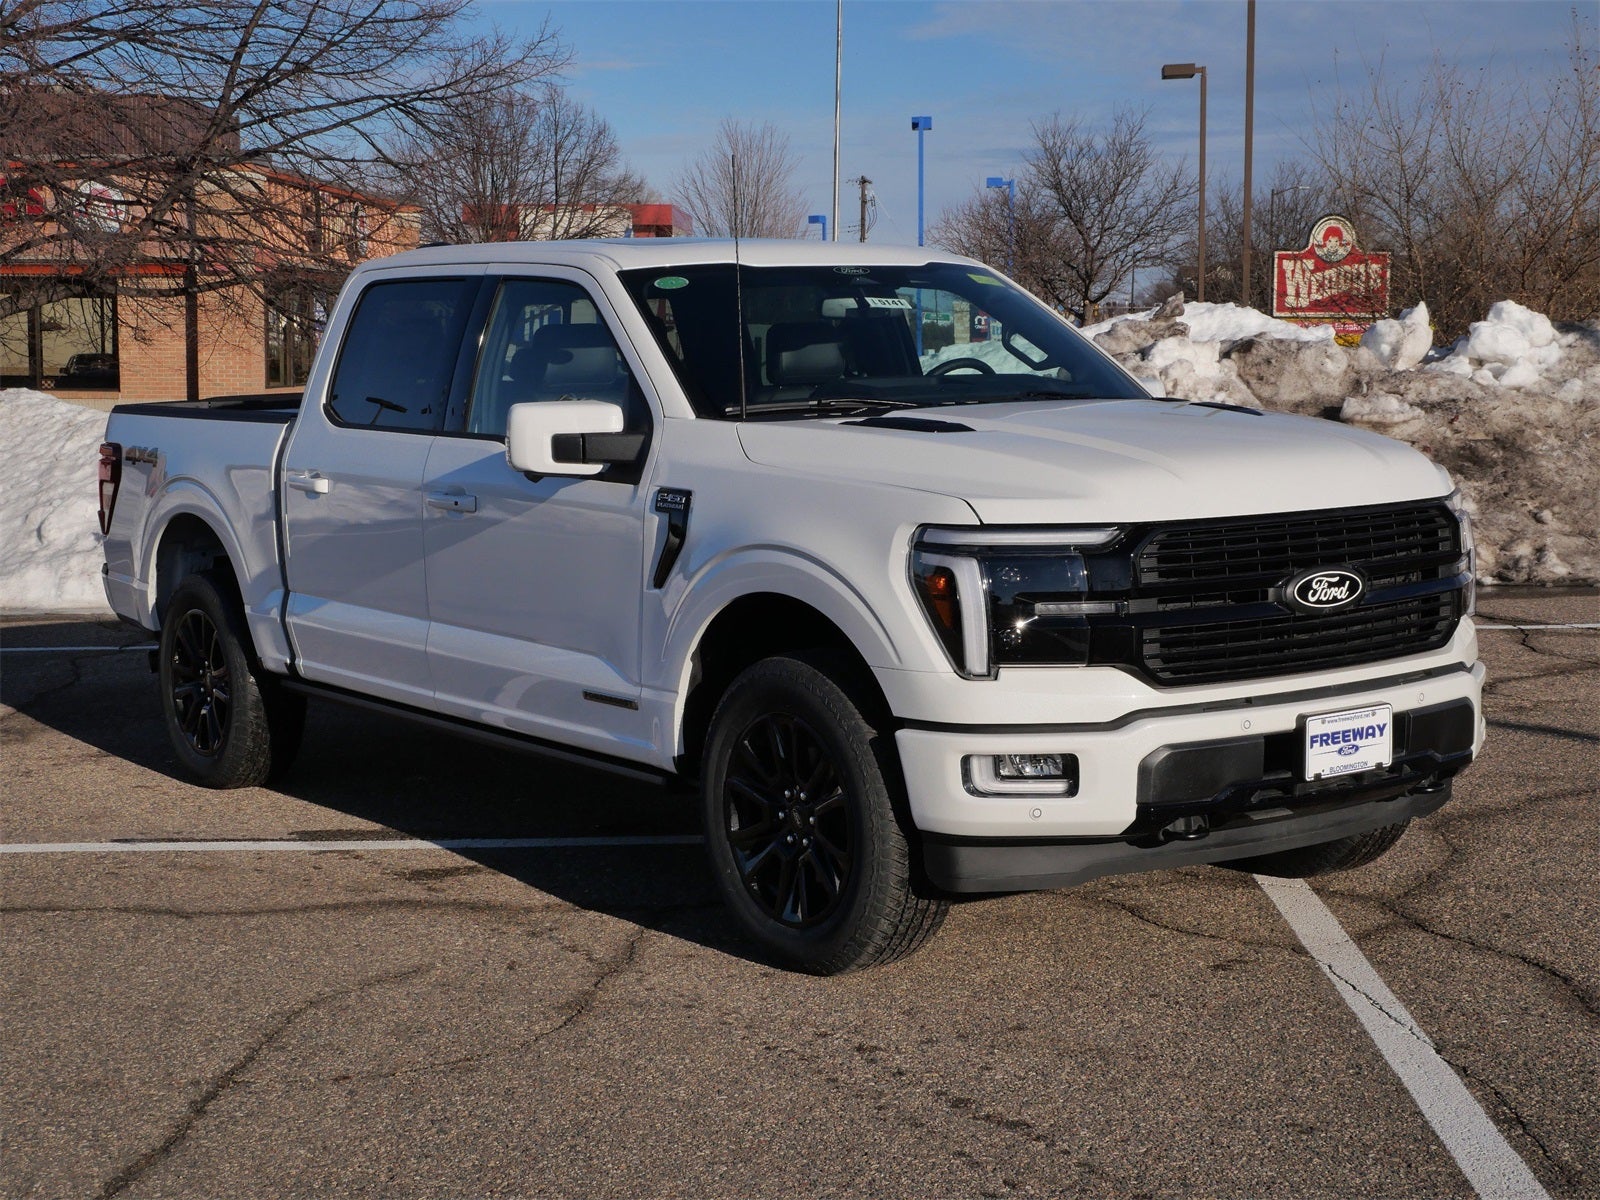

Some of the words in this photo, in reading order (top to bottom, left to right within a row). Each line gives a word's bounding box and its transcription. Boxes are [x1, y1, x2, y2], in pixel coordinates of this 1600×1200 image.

[1308, 576, 1350, 602] Ford
[1327, 712, 1371, 723] www.freewayford.net
[1310, 723, 1387, 748] FREEWAY
[1339, 745, 1357, 755] Ford
[1330, 761, 1368, 773] BLOOMINGTON
